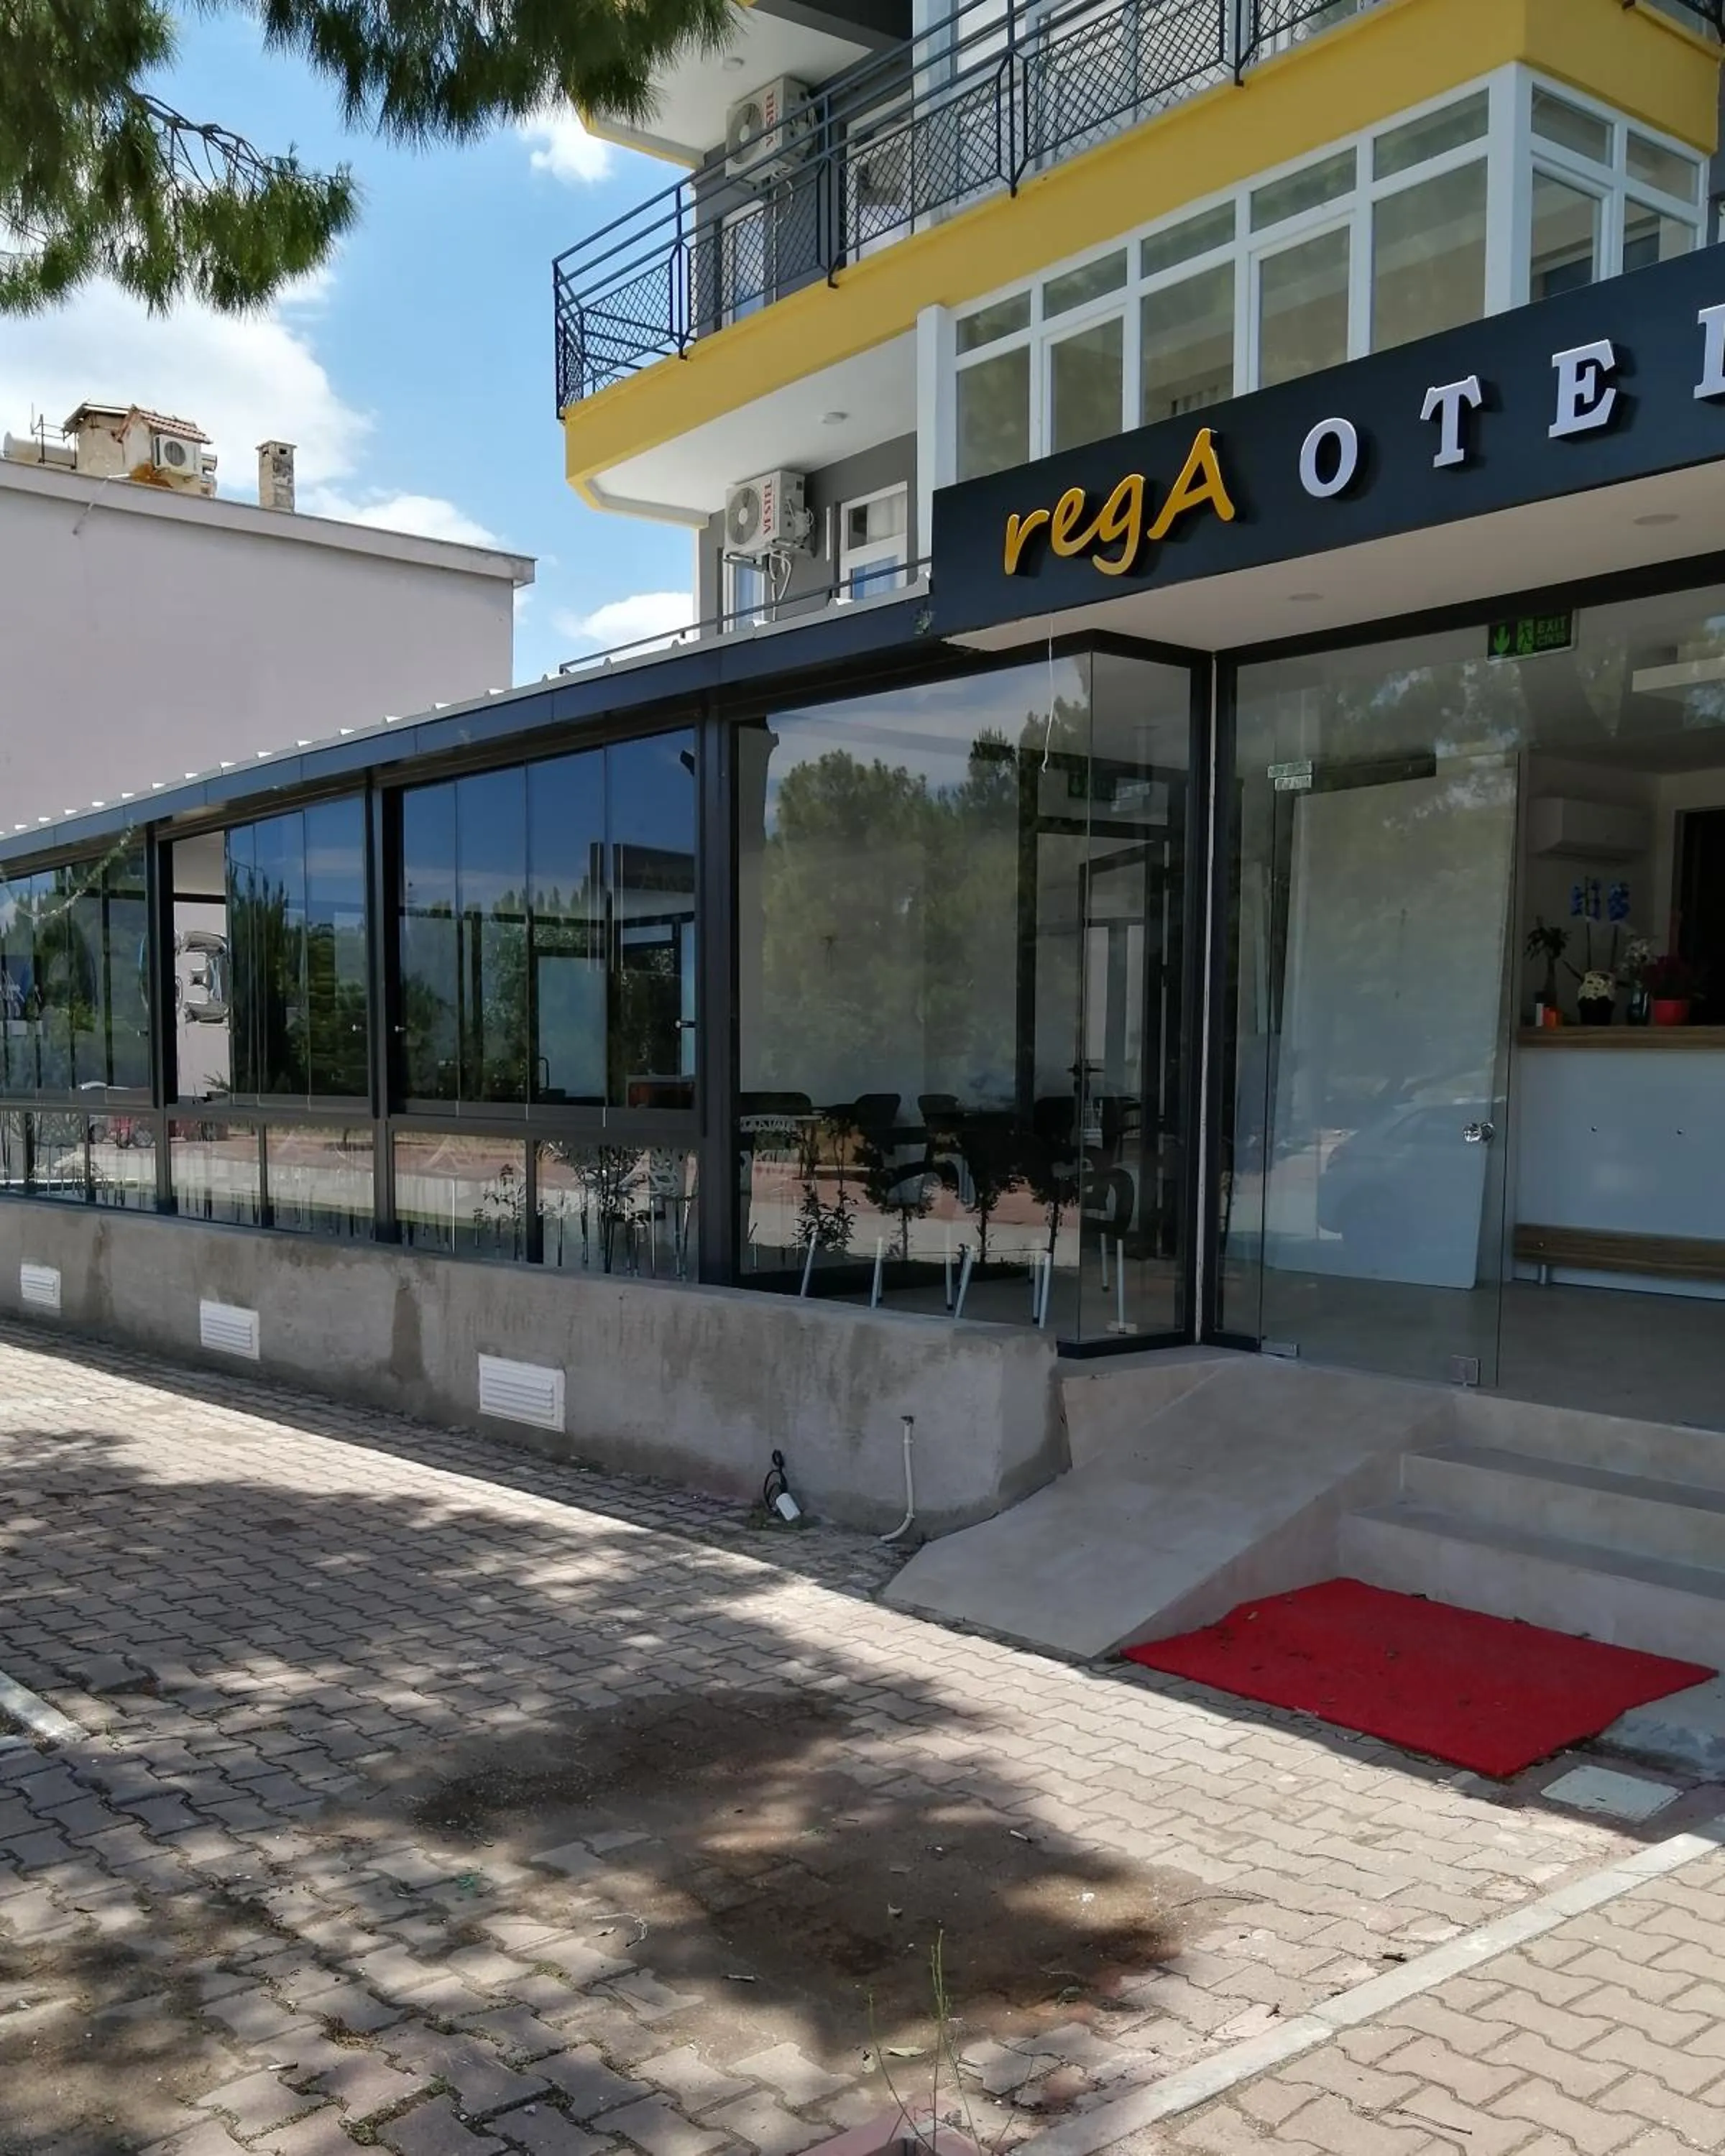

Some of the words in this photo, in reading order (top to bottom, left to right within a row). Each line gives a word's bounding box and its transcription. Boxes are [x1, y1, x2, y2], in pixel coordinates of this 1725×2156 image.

[763, 479, 773, 535] VESTEL
[1004, 428, 1235, 576] regA
[1537, 615, 1567, 634] EXIT
